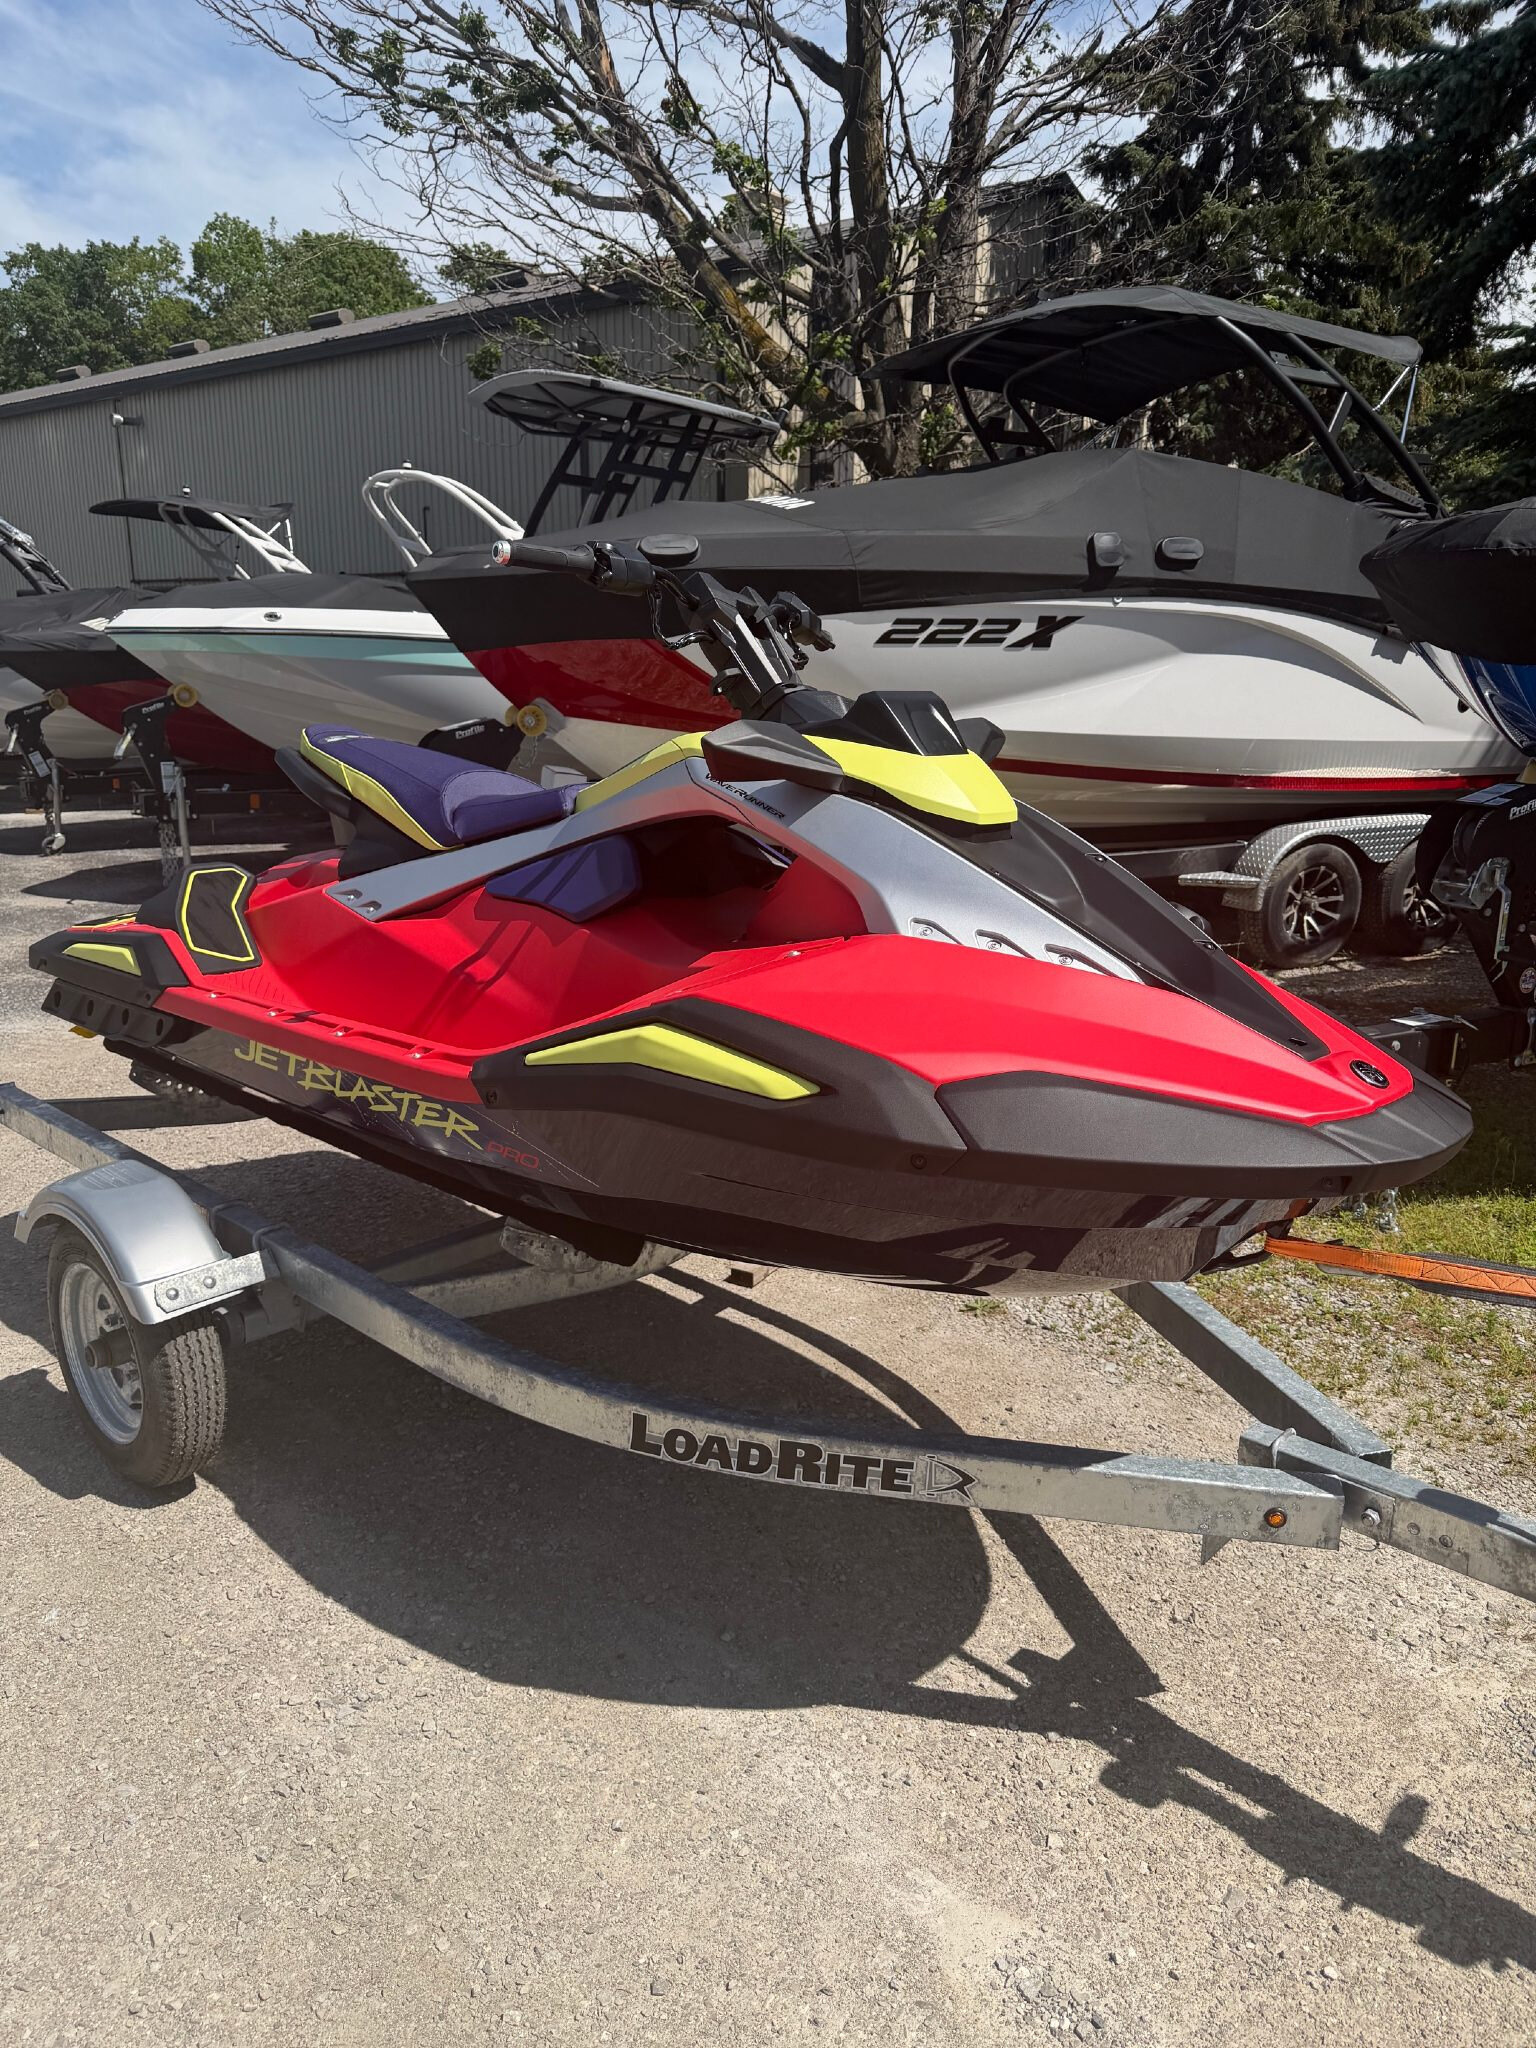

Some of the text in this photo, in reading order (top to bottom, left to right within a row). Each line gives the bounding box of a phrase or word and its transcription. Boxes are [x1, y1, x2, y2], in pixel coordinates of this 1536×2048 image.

[873, 615, 1086, 651] 222X
[455, 725, 485, 740] Profile
[234, 1039, 539, 1169] JETBLASTER PRO
